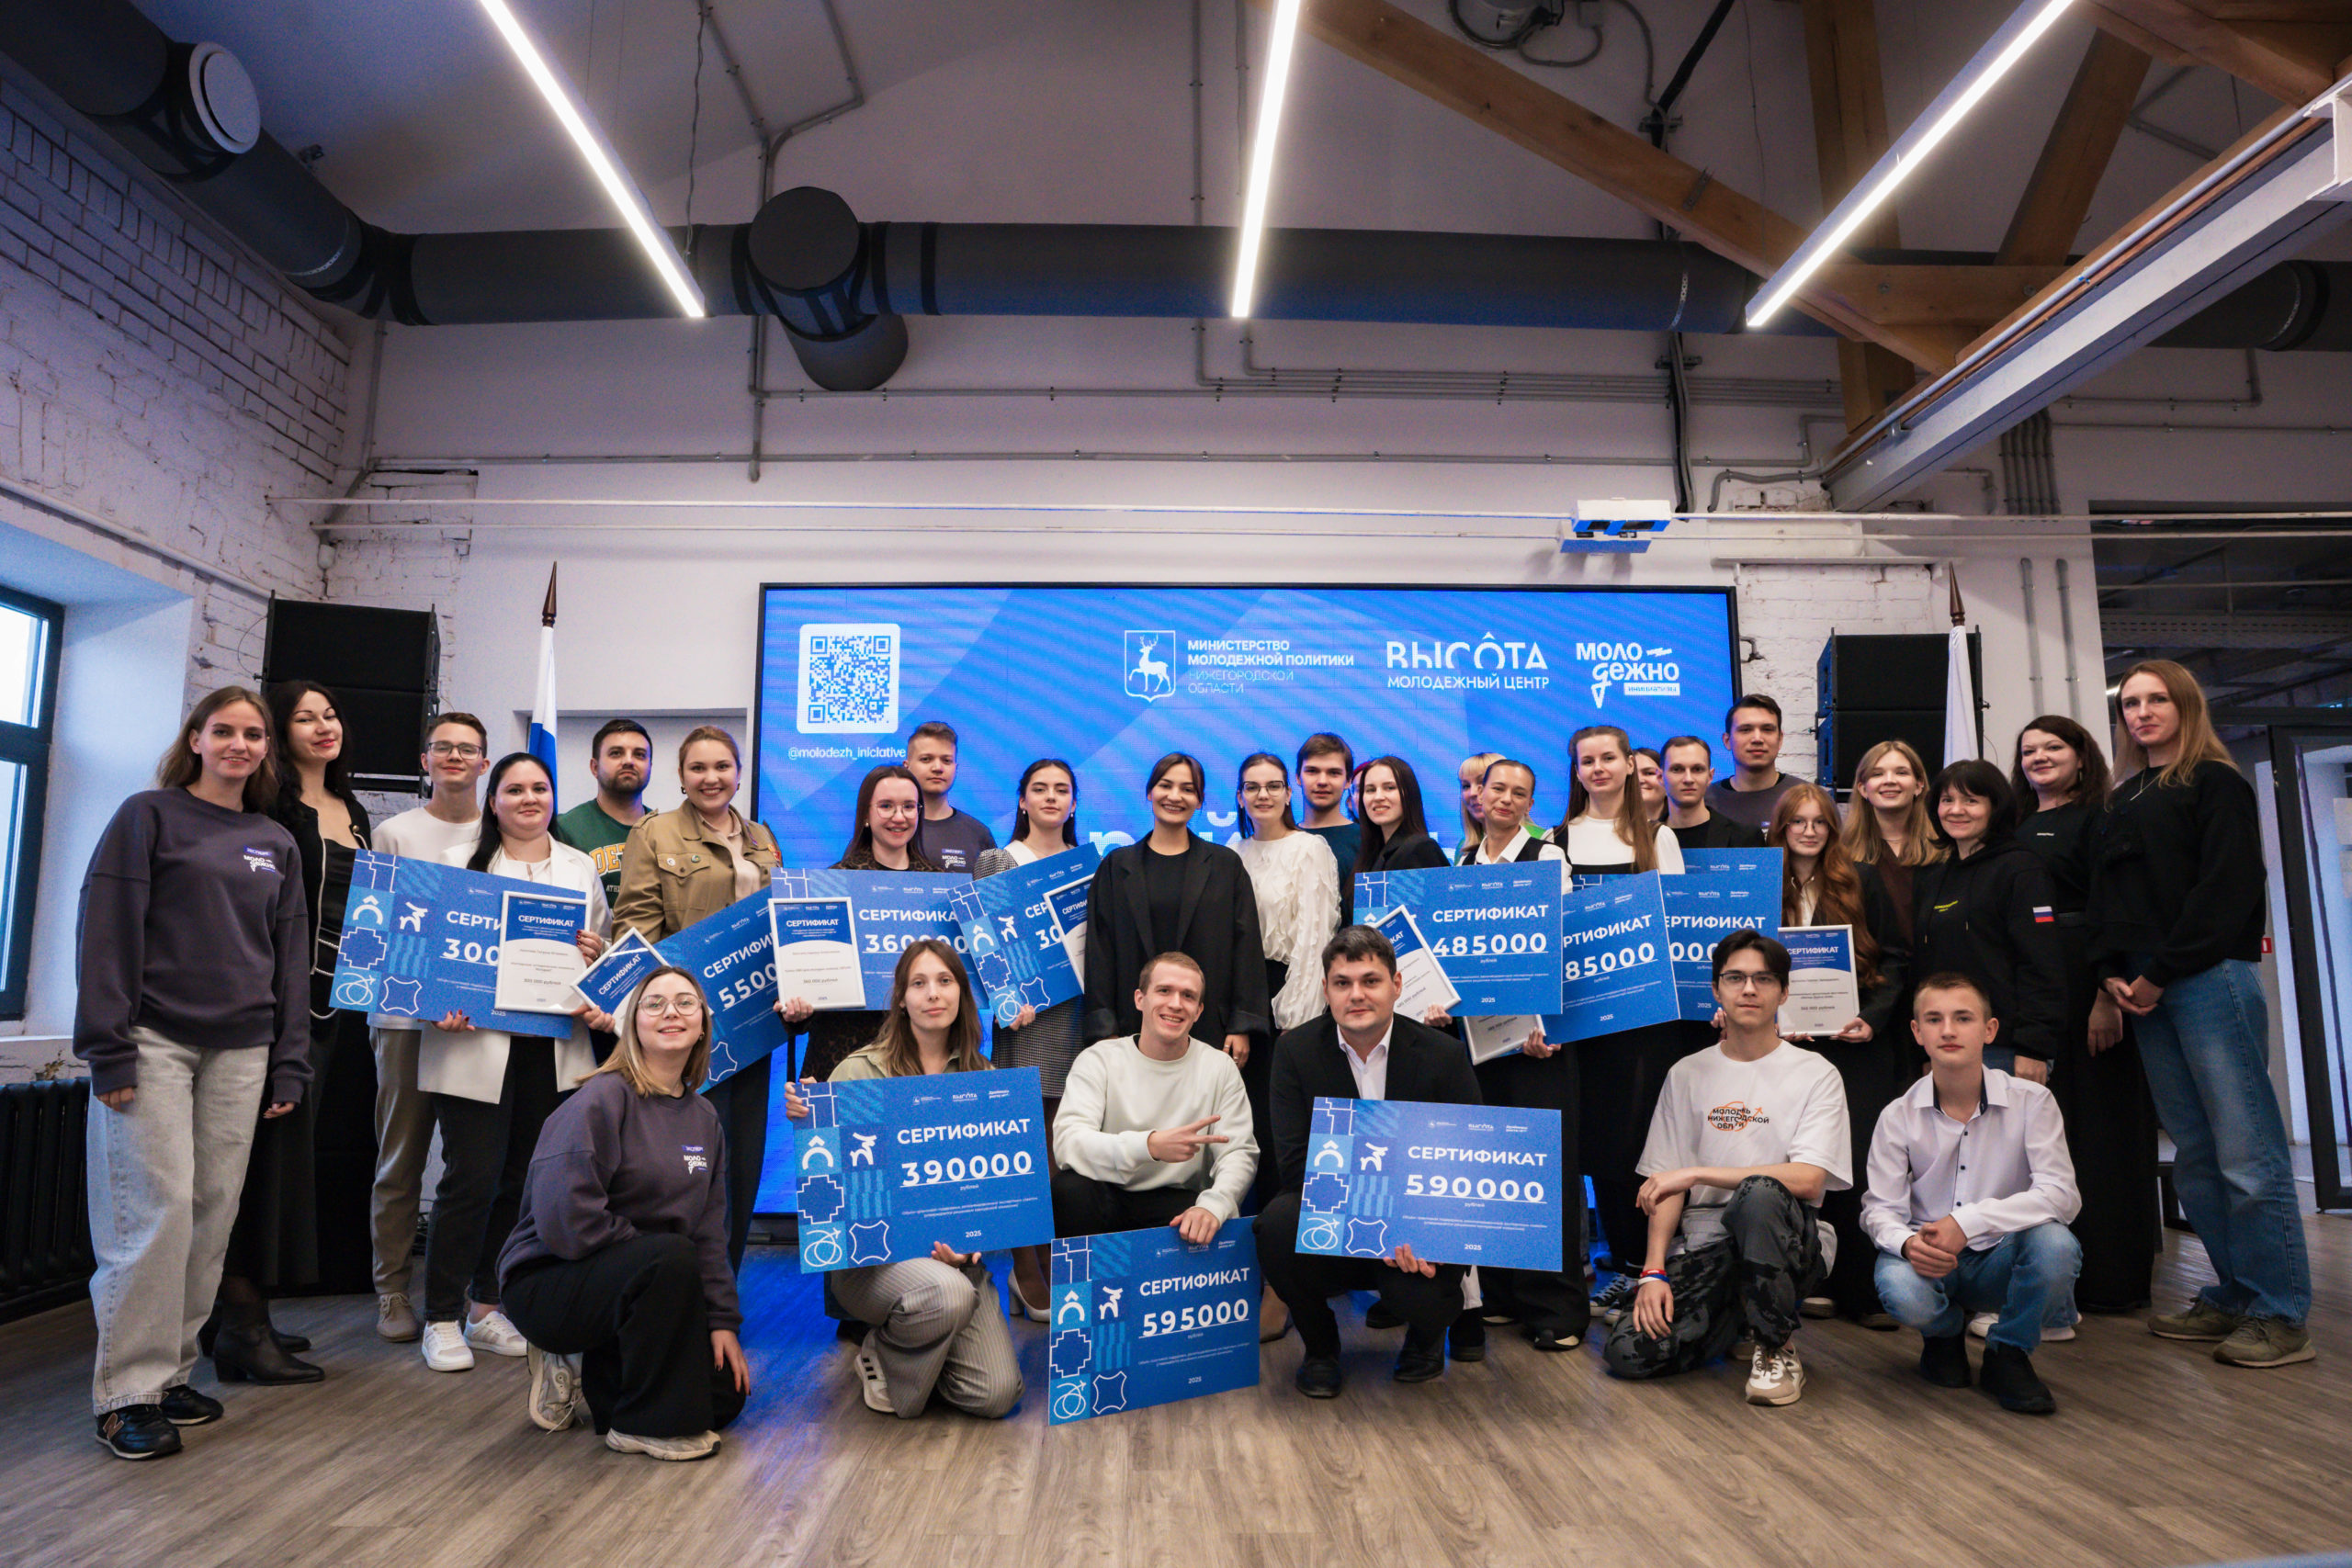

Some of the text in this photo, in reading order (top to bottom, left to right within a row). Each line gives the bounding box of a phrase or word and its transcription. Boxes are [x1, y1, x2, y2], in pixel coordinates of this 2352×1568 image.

[1188, 640, 1290, 651] МИНИСТЕРСТВО
[1188, 652, 1354, 667] МОЛОДЕЖНОЙ ПОЛИТИКИ
[1188, 682, 1244, 694] ОБЛАСТИ
[1387, 673, 1550, 691] МОЛОДЕЖНЫЙ ЦЕНТР
[788, 746, 907, 761] @molodezh_iniciative
[517, 915, 575, 928] СЕРТИФИКАТ
[786, 919, 840, 927] СЕРТИФИКАТ
[1432, 905, 1549, 923] СЕРТИФИКАТ
[1433, 933, 1547, 956] 485000
[1787, 946, 1839, 954] СЕРТИФИКАТ
[598, 953, 642, 995] СЕРТИФИКАТ
[897, 1118, 1031, 1145] СЕРТИФИКАТ
[1408, 1145, 1548, 1167] СЕРТИФИКАТ
[901, 1151, 1033, 1187] 390000
[1406, 1174, 1544, 1203] 590000
[965, 1230, 982, 1238] 2025
[1464, 1243, 1482, 1251] 2025
[1139, 1267, 1250, 1297] СЕРТИФИКАТ
[1142, 1298, 1250, 1337] 595000
